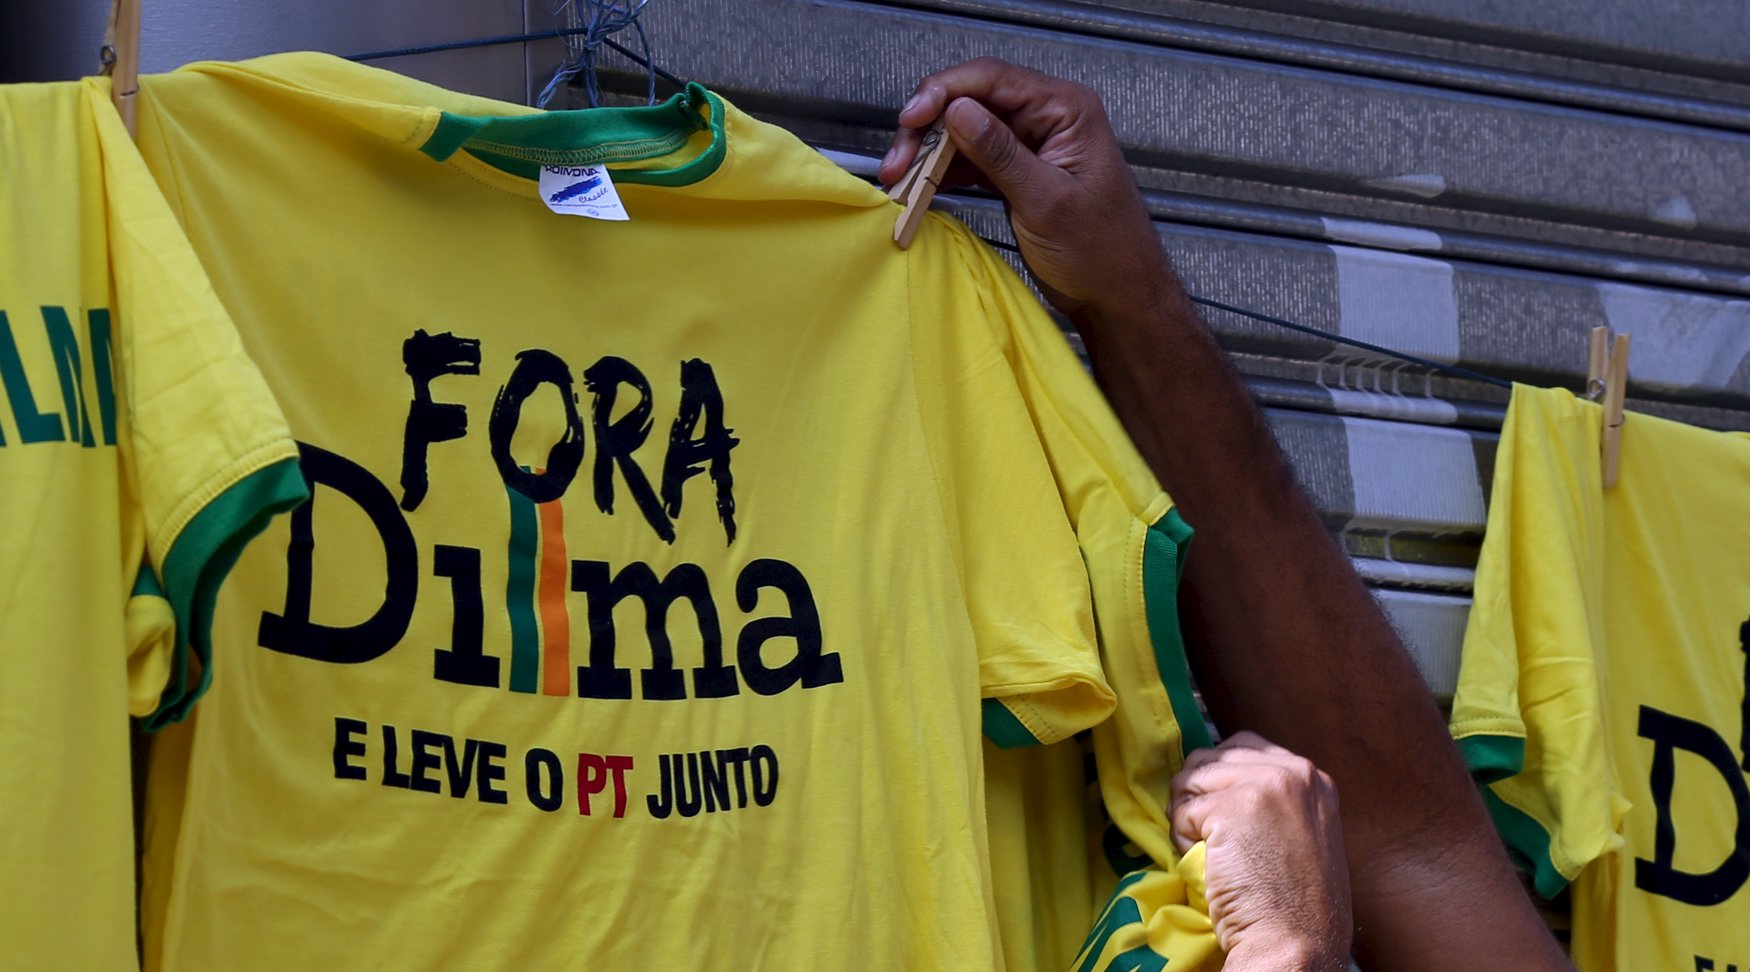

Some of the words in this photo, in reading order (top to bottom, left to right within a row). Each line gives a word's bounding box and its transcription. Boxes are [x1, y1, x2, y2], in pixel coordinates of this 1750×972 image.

[401, 328, 740, 545] FORA
[258, 441, 843, 701] Dilma
[334, 717, 367, 780] E
[382, 725, 507, 804] LEVE
[525, 748, 563, 812] O
[578, 753, 633, 818] PT
[646, 745, 779, 819] JUNTO
